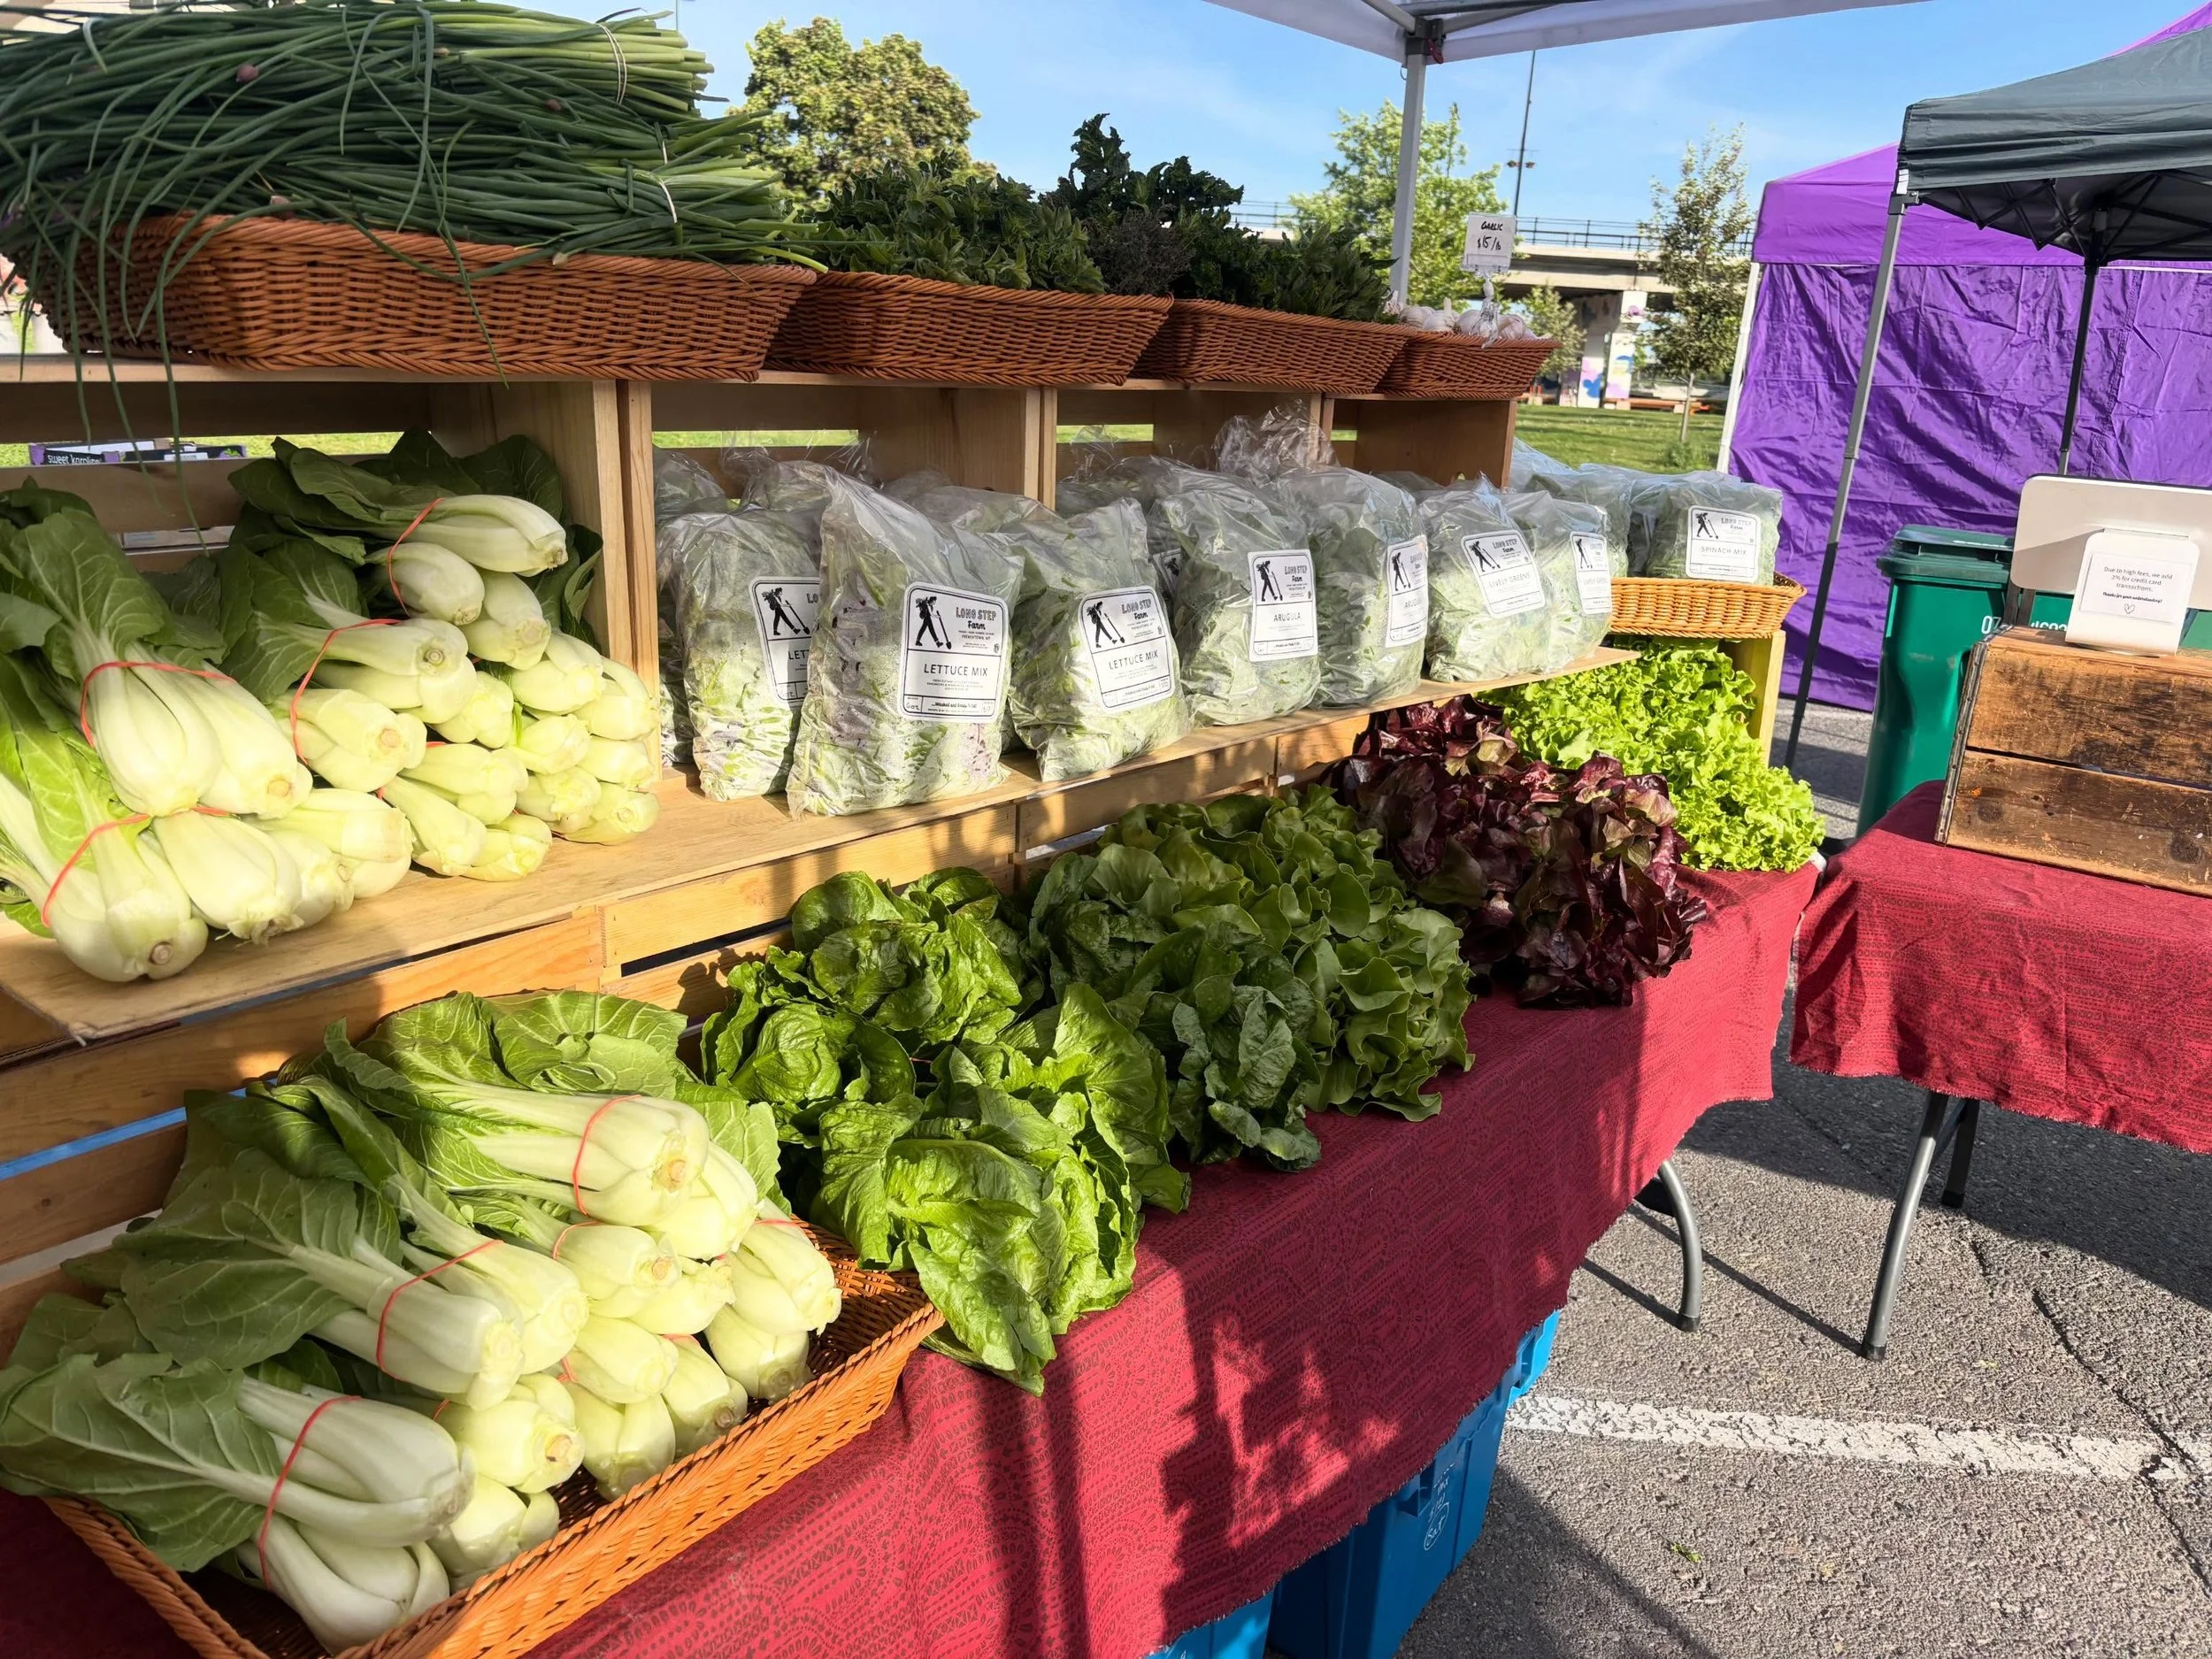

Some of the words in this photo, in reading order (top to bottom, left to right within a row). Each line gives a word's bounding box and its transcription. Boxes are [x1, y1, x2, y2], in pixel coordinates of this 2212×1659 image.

[1481, 220, 1503, 231] GARLIC
[1701, 546, 1732, 555] SPINACH
[1509, 572, 1531, 582] GREENS
[1121, 602, 1139, 615] LONG
[1140, 598, 1151, 610] STEP
[956, 607, 976, 619] LONG
[977, 610, 996, 621] STEP
[1273, 612, 1302, 622] ARUGULA
[967, 620, 986, 630] Farm
[1109, 654, 1143, 670] LETTUCE
[1146, 649, 1159, 661] MIX
[924, 664, 968, 675] LETTUCE
[972, 667, 988, 676] MIX
